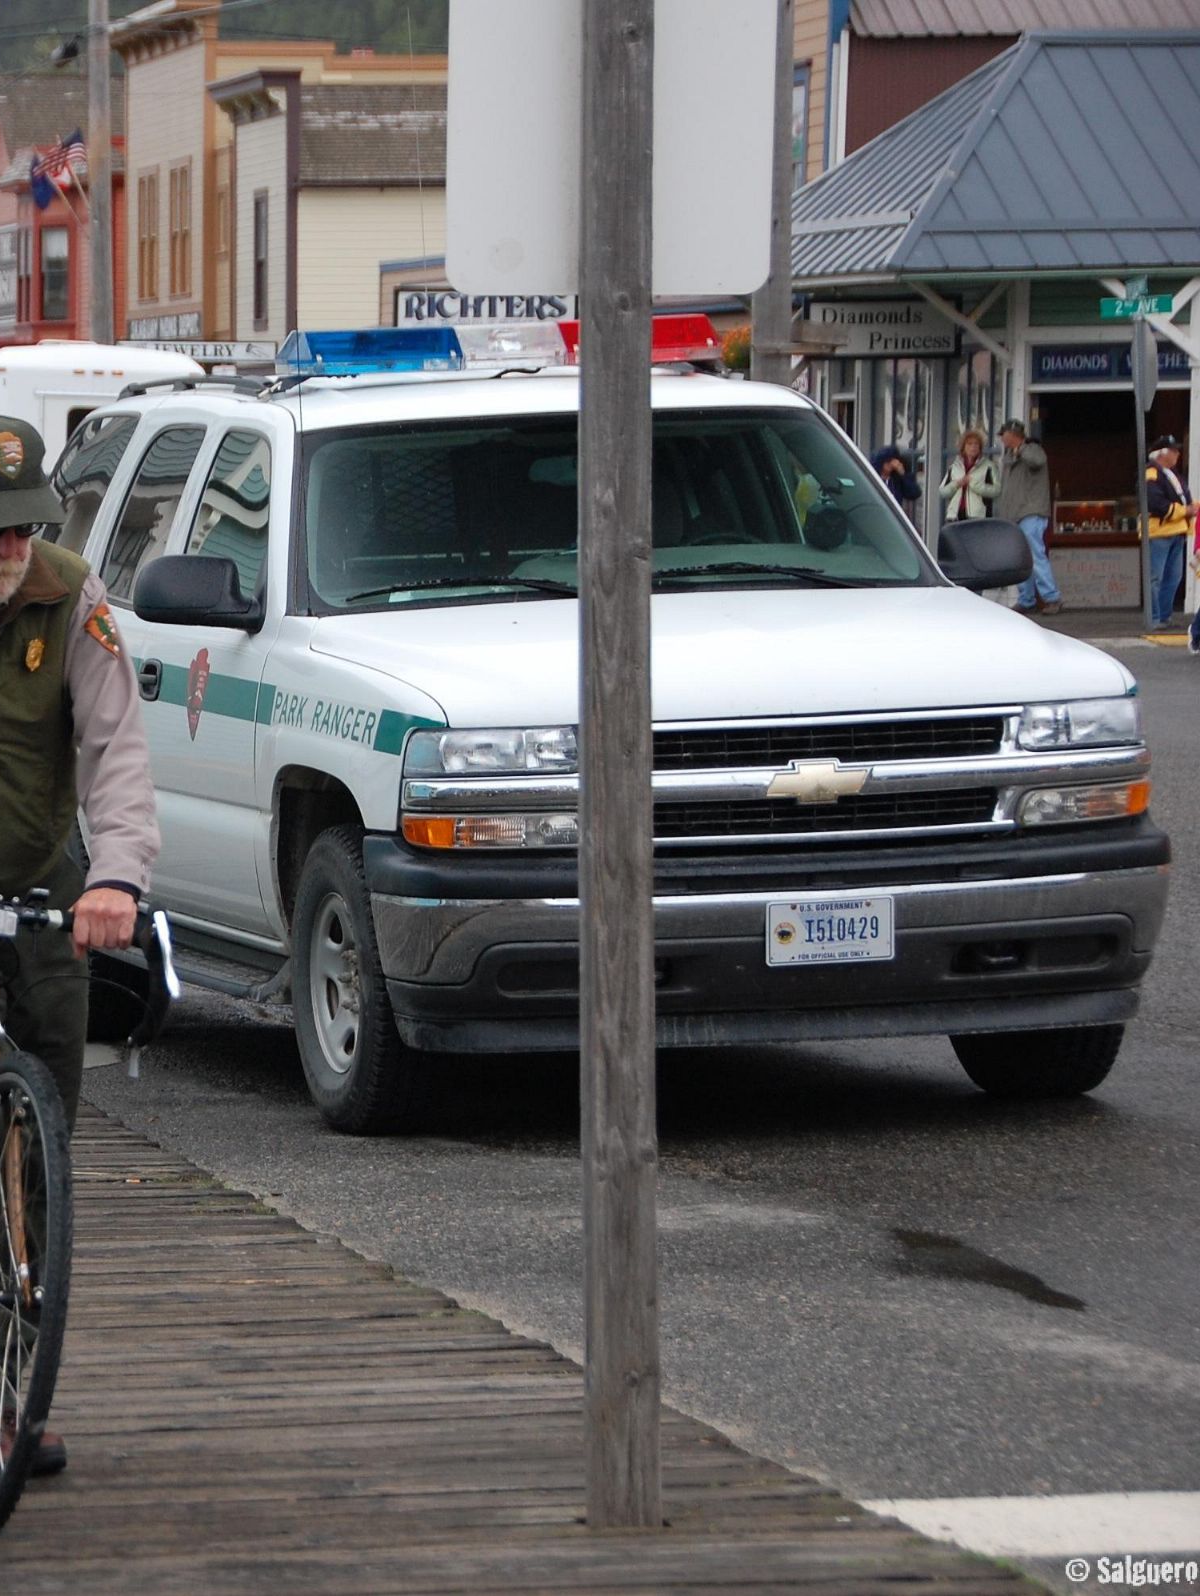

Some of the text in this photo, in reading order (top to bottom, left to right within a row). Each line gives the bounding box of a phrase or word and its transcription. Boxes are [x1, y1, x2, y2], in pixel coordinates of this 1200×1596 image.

[822, 305, 923, 325] Diamonds
[1136, 298, 1159, 314] AVE
[869, 331, 951, 350] Princess
[1042, 354, 1108, 370] DIAMONDS
[273, 691, 376, 744] PARK RANGER
[800, 901, 864, 912] U.S. GOVERNMENT
[805, 915, 879, 943] I510429
